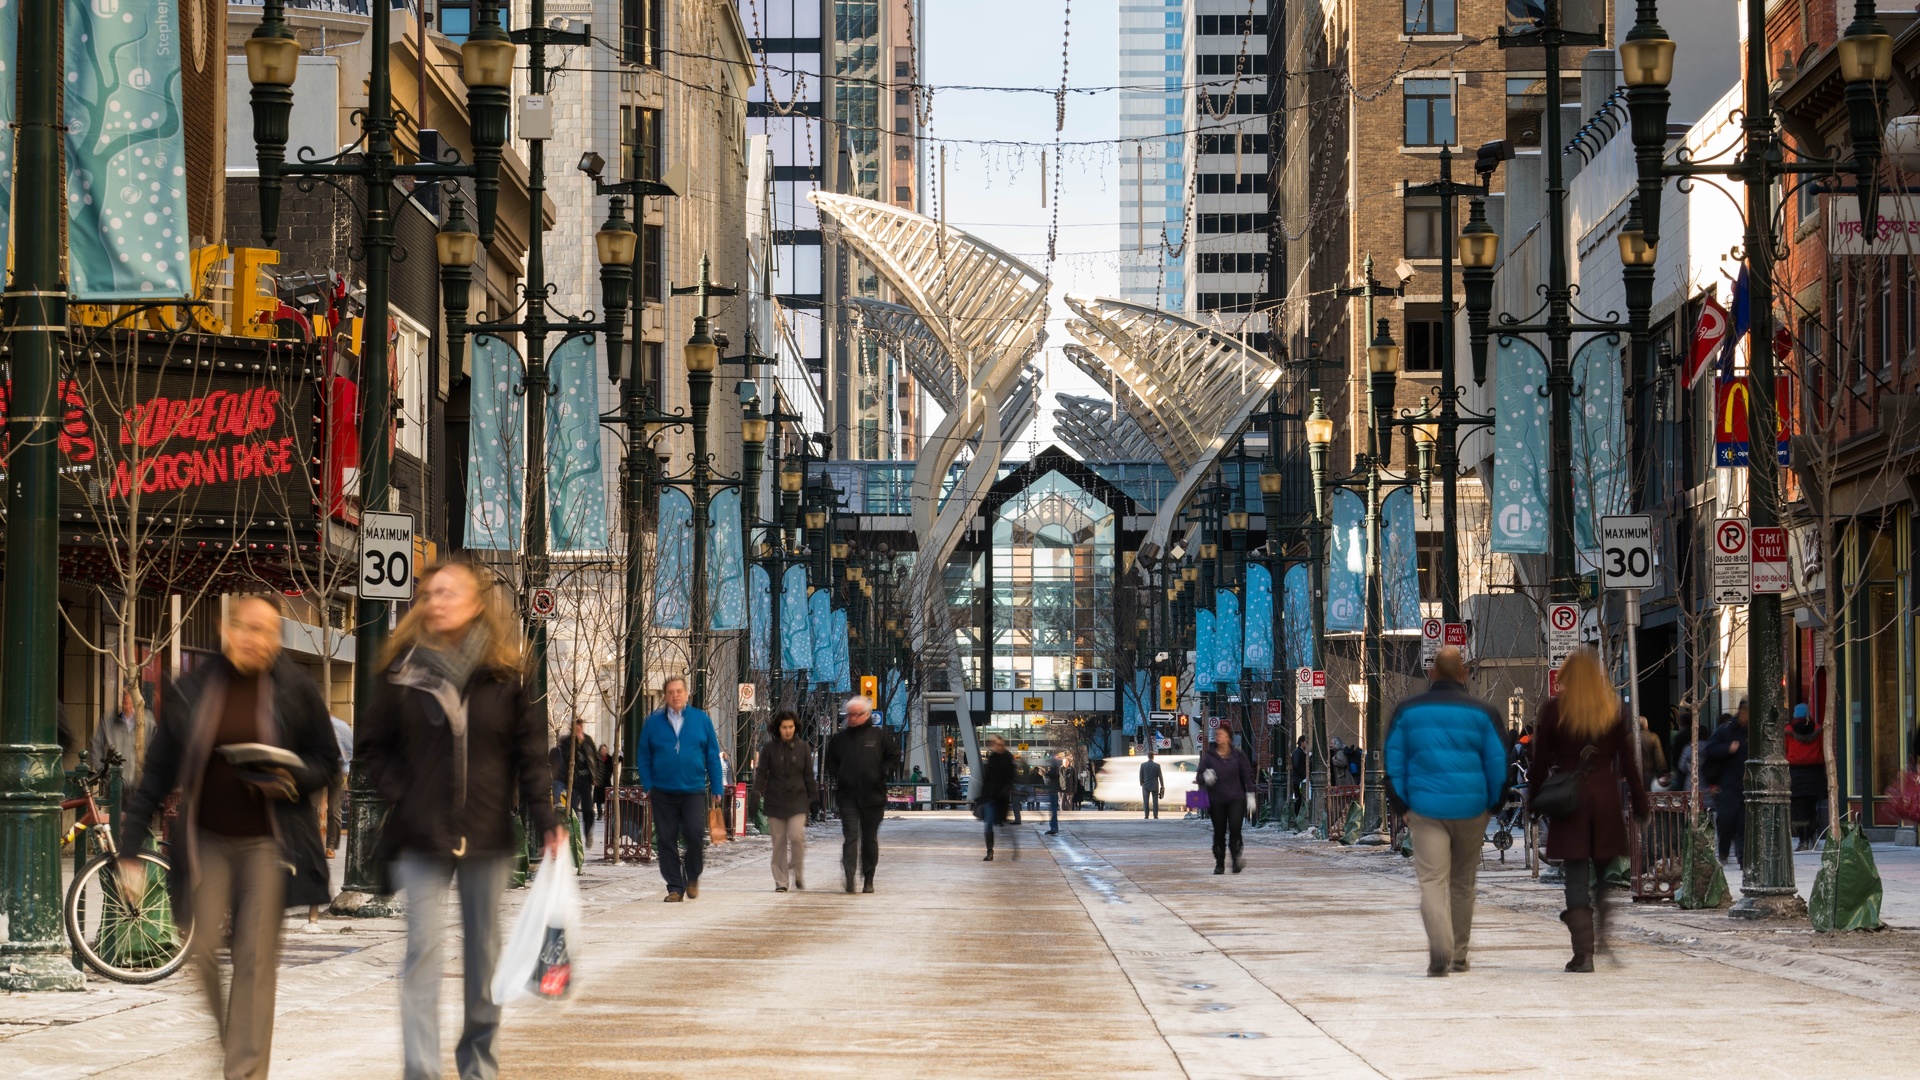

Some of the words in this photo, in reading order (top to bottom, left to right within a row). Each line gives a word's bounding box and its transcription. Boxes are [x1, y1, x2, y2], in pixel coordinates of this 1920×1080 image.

[1839, 215, 1902, 243] mago
[107, 446, 228, 498] MORGAN
[233, 437, 294, 480] PAGE
[366, 527, 410, 542] MAXIMUM
[1604, 528, 1648, 539] MAXIMUM
[1759, 533, 1781, 544] TAXI
[1716, 554, 1748, 563] 06:00-18:00
[1760, 546, 1781, 557] ONLY
[364, 550, 409, 588] 30
[1605, 546, 1650, 578] 30
